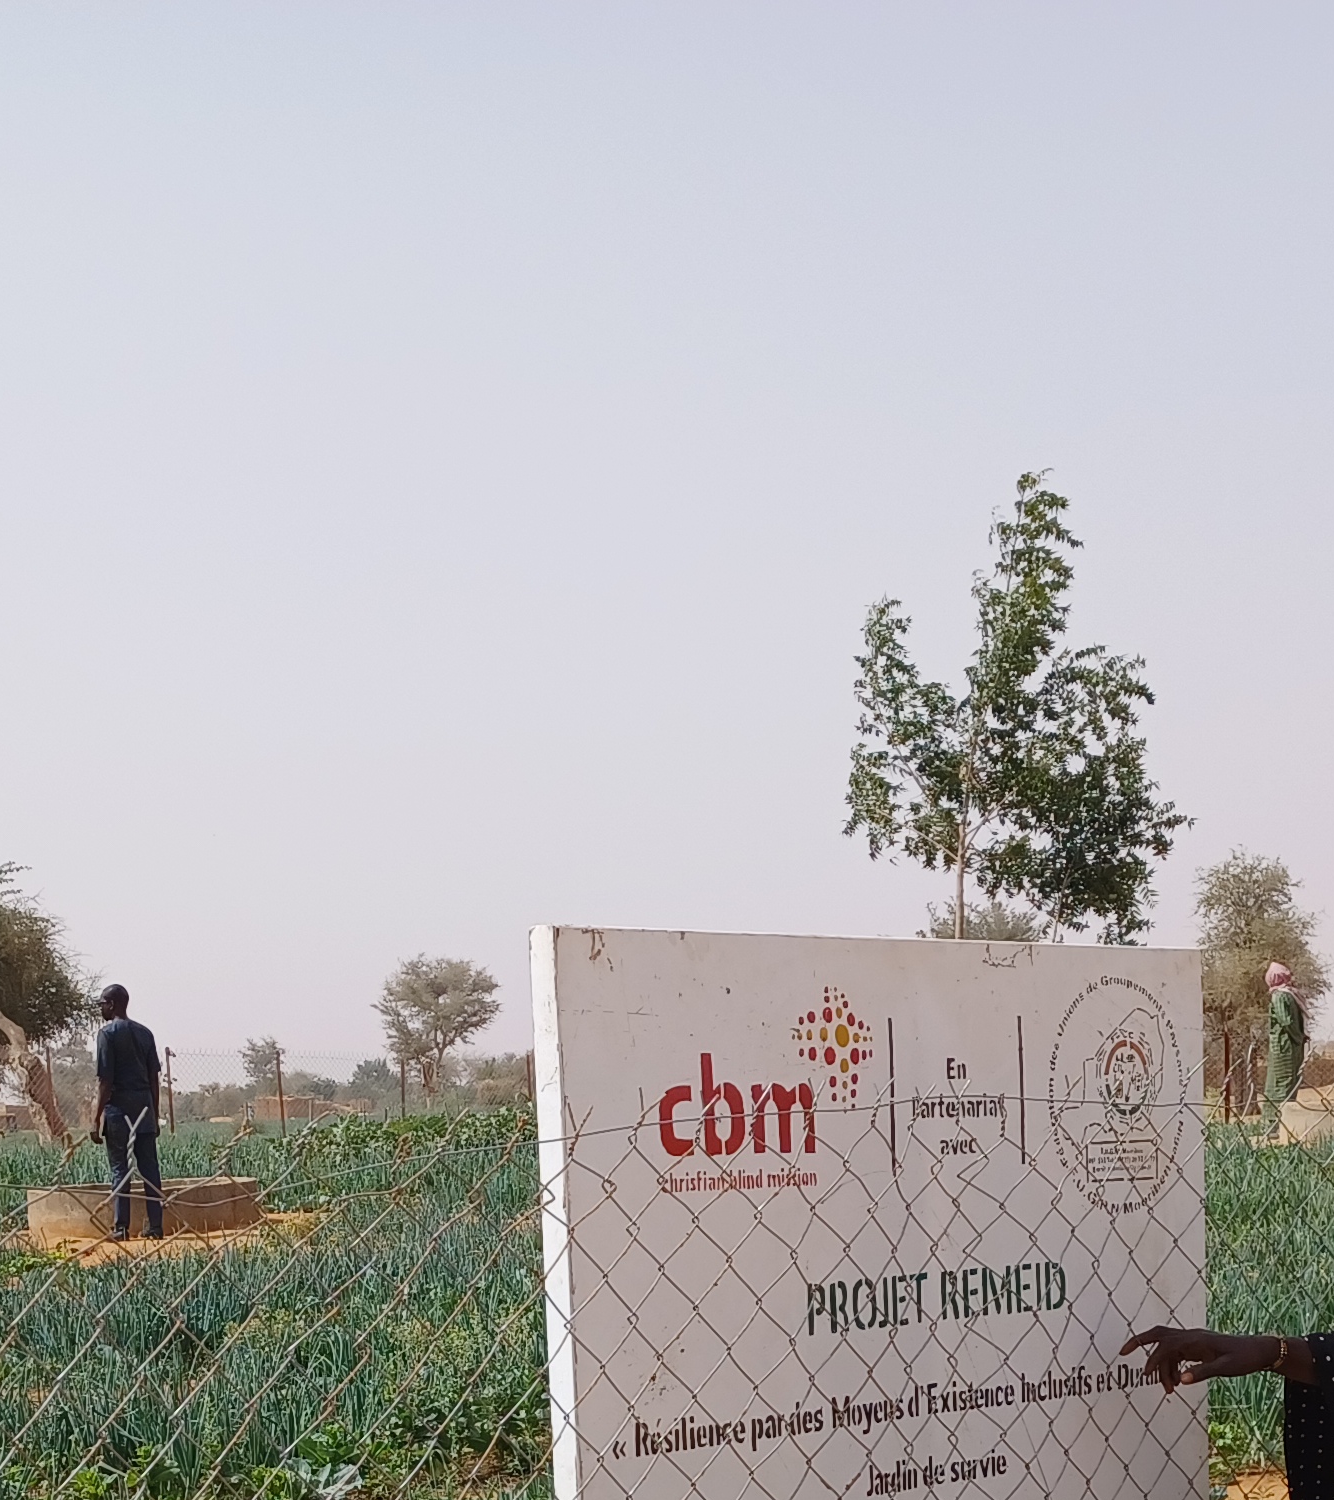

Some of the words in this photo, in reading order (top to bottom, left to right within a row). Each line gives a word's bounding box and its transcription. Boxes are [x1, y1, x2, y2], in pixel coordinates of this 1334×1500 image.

[947, 1057, 967, 1080] En
[659, 1053, 816, 1156] cbm
[939, 1138, 977, 1155] avec
[808, 1271, 927, 1336] PROJET
[940, 1261, 1066, 1321] REMEID
[635, 1415, 746, 1457] Résilience
[832, 1396, 904, 1434] Moyens
[1021, 1365, 1092, 1403] Inclusifs
[1097, 1368, 1113, 1393] et
[866, 1459, 918, 1496] Jardin
[923, 1456, 945, 1486] de
[950, 1448, 1007, 1482] survie
